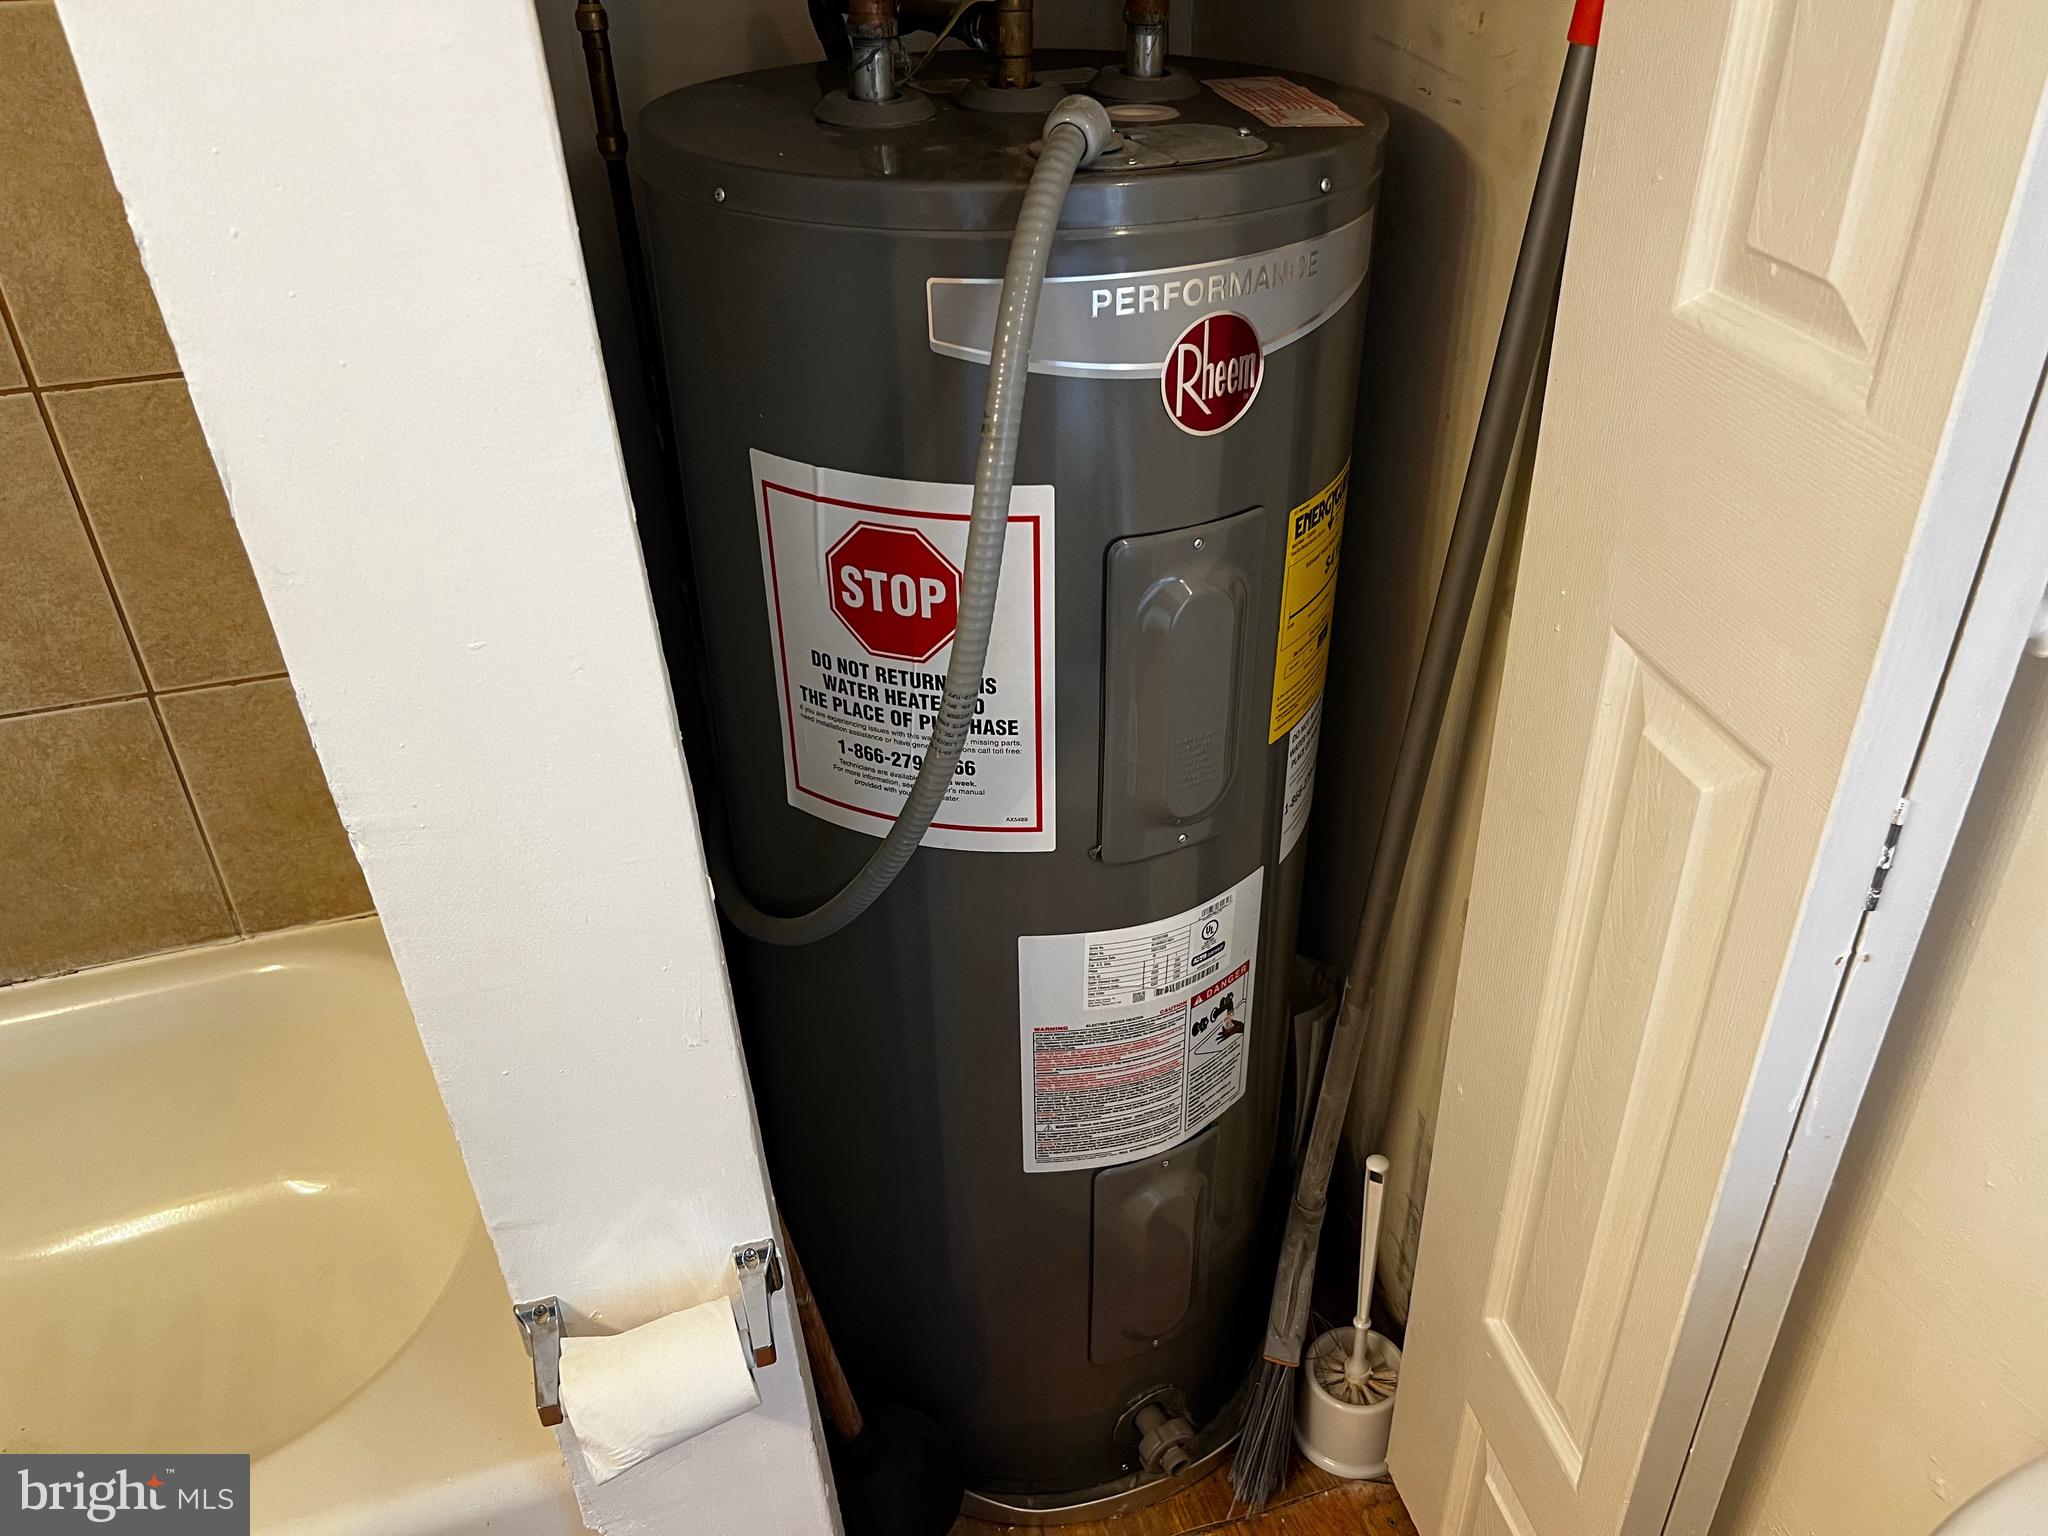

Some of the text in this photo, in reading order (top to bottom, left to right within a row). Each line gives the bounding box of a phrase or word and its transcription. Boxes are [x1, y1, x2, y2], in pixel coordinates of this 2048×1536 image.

[1092, 250, 1319, 318] PERFORMANCE
[1176, 319, 1256, 417] Rheem
[840, 565, 946, 618] STOP
[811, 650, 832, 670] DO
[837, 657, 869, 680] NOT
[875, 666, 946, 691] RETURN
[800, 684, 828, 709] THE
[832, 696, 884, 724] PLACE
[890, 710, 913, 728] OF
[823, 673, 985, 715] WATER HEATE O
[816, 719, 848, 733] installation
[848, 729, 882, 742] assistance
[894, 738, 910, 746] have
[827, 714, 866, 732] experiencing
[868, 723, 890, 735] issues
[891, 728, 906, 738] with
[907, 732, 919, 740] this
[834, 764, 844, 772] For
[845, 769, 860, 778] more
[840, 758, 876, 774] Technicians
[855, 780, 882, 790] provided
[884, 784, 897, 793] with
[1206, 965, 1247, 998] DANGER
[1160, 1001, 1188, 1014] CAUTION
